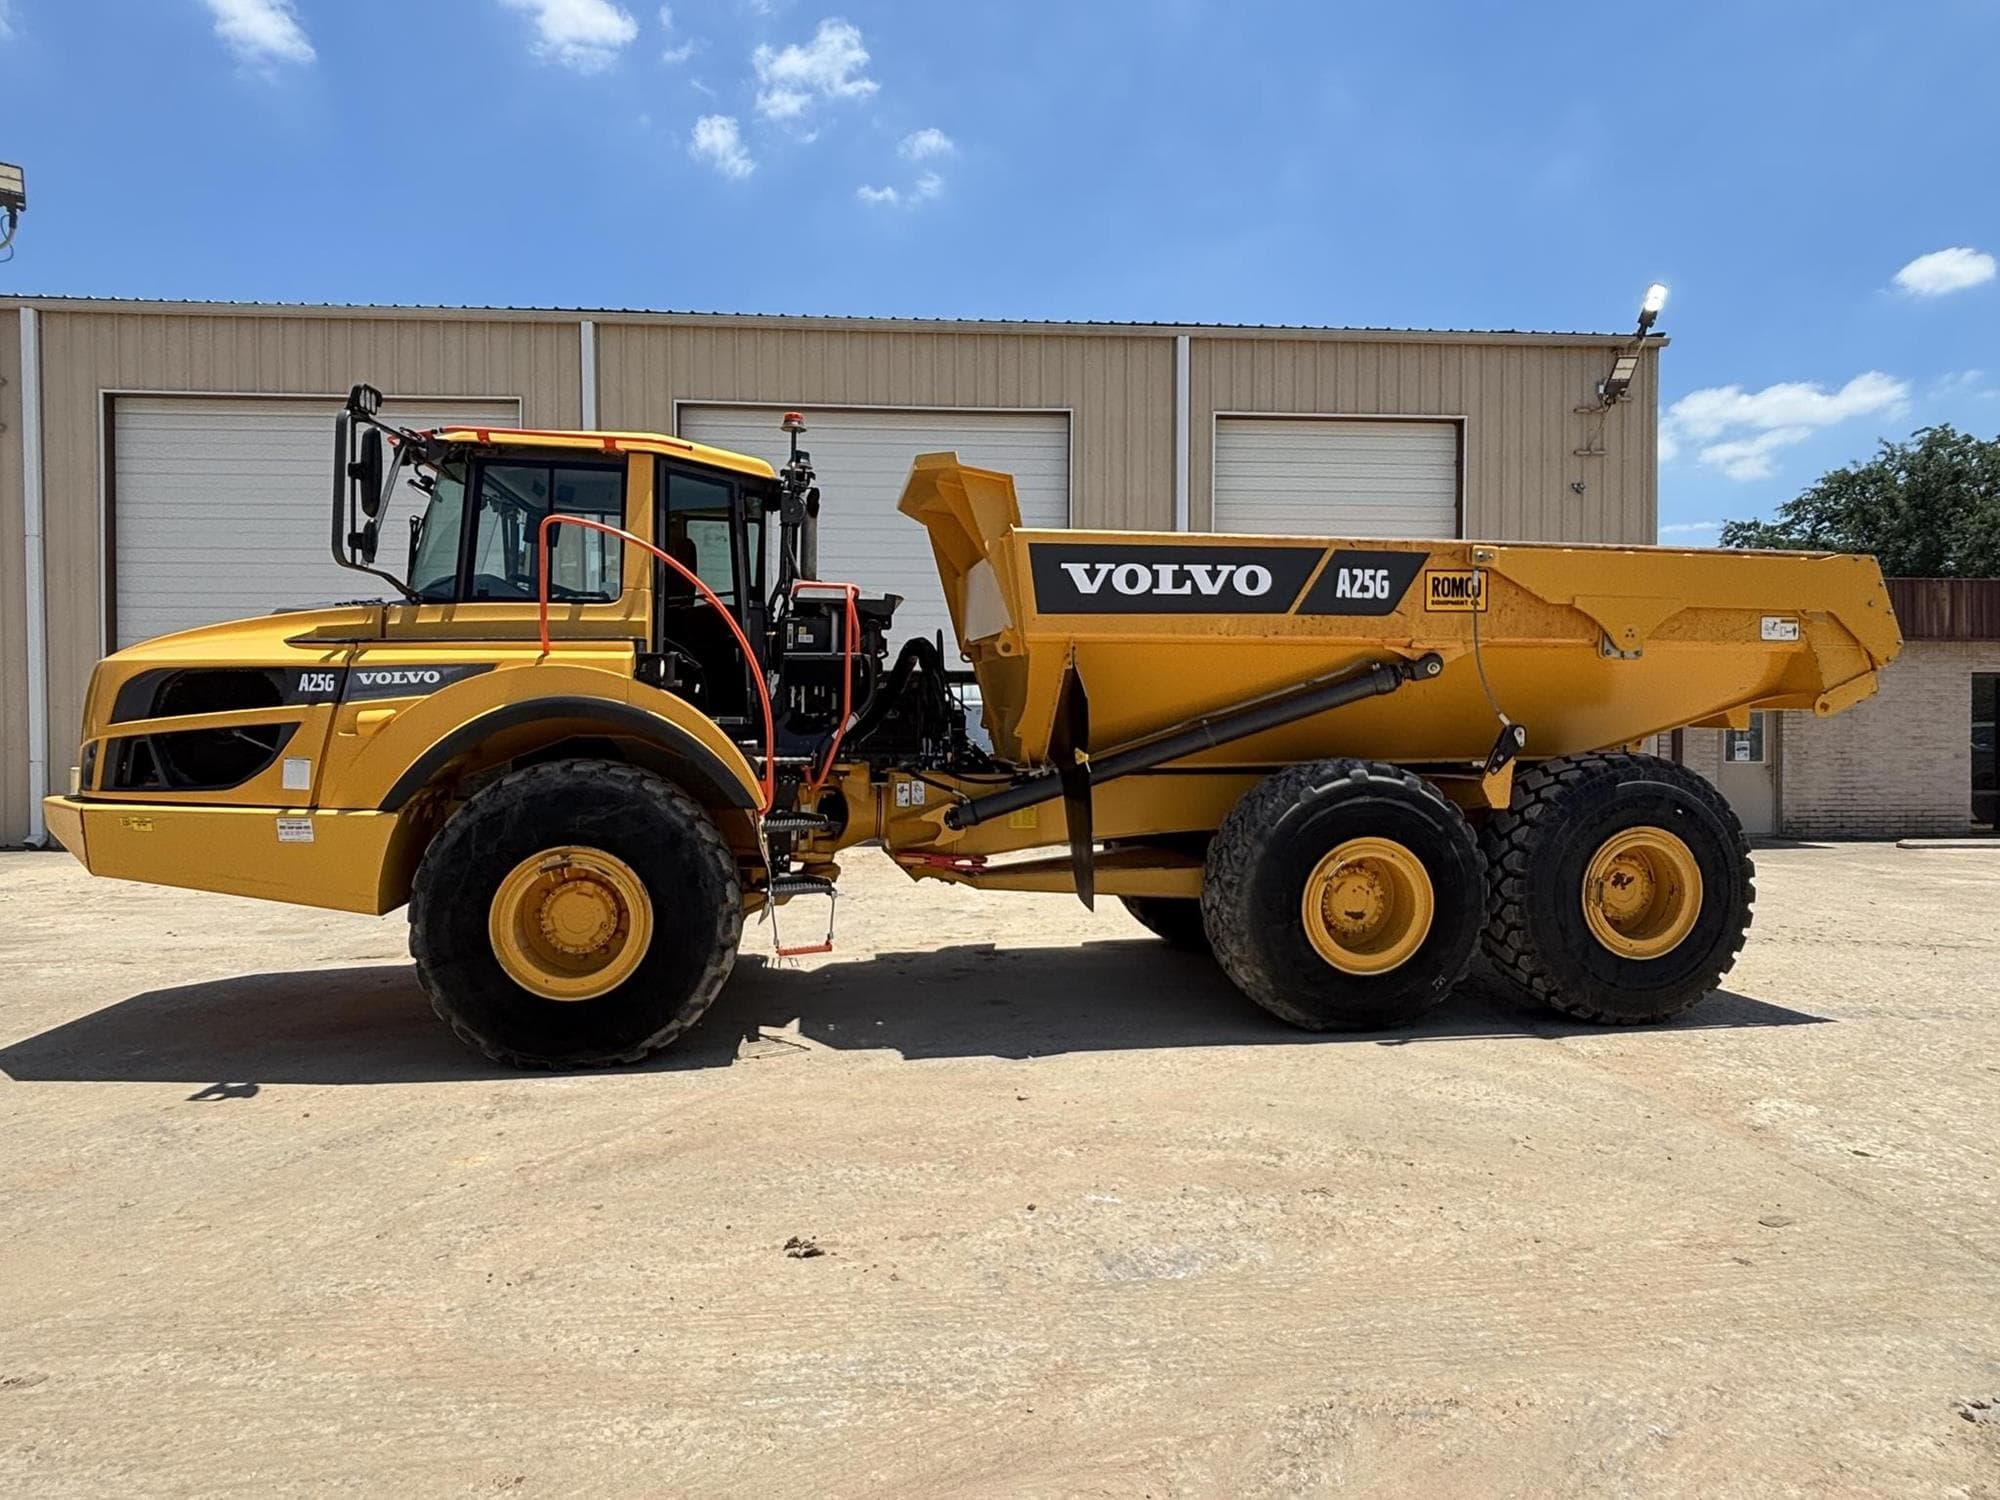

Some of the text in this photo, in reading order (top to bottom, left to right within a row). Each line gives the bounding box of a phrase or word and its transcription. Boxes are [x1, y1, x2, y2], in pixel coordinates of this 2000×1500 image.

[1060, 563, 1390, 599] VOLVO A25G
[298, 673, 335, 692] A25G
[356, 670, 441, 685] VOLVO
